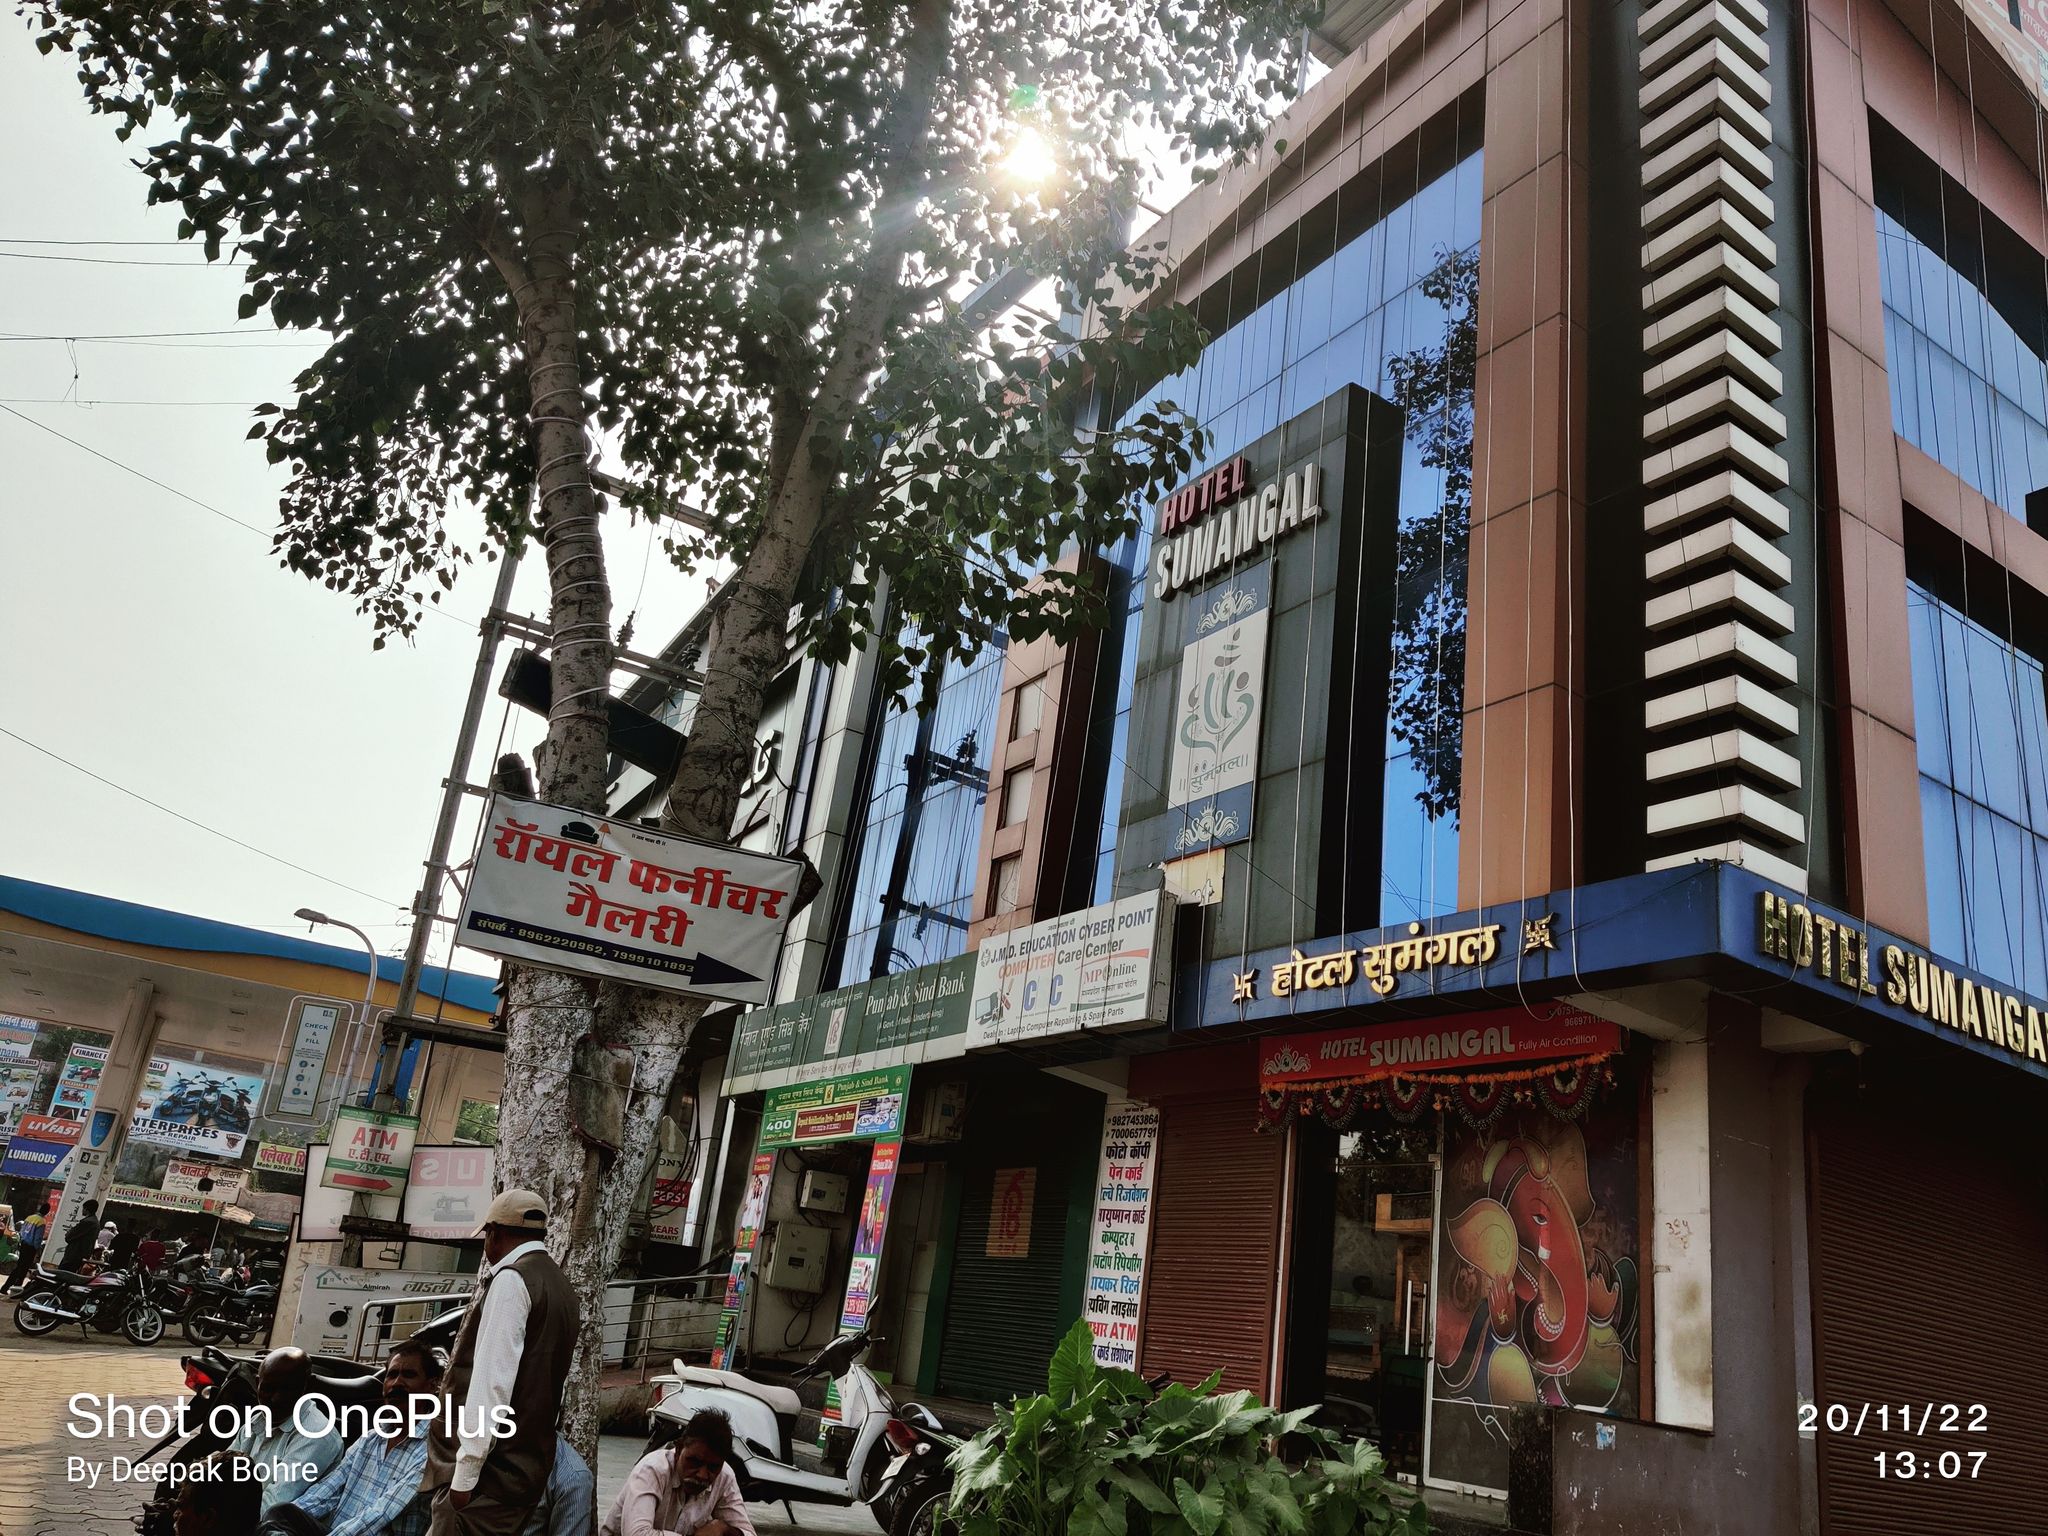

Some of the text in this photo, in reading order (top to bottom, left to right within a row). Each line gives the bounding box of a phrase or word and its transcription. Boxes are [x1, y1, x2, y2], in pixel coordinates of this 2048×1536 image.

[1160, 455, 1247, 538] HOTEL
[1153, 462, 1323, 601] SUMANGAL
[494, 817, 789, 920] रॉयल फर्नीचर
[565, 880, 695, 947] गैलरी
[991, 907, 1154, 963] J.M.D. EDUCATION CYBER POINT
[998, 938, 1125, 980] COMPUTER Care Center
[1271, 921, 1501, 998] होटल सुमंगल
[1759, 890, 2048, 1063] HOTEL SUMANGA
[865, 988, 900, 1018] Punjab
[900, 985, 911, 1008] &
[912, 978, 937, 1005] Sind
[937, 971, 966, 999] Bank
[1107, 1007, 1124, 1018] Parts
[305, 1022, 329, 1031] CHECK
[1320, 1026, 1598, 1067] HOTEL SUMANGAL Fully Air Condition
[28, 1115, 80, 1136] LIVFAST
[766, 1119, 792, 1131] 400
[1110, 1127, 1157, 1139] 7000657791
[352, 1126, 399, 1151] ATM
[1105, 1141, 1128, 1160] फोटो
[7, 1148, 58, 1165] LUMINOUS
[1108, 1162, 1144, 1181] पेन कार्ड
[1132, 1205, 1146, 1225] कार्ड
[1109, 1322, 1137, 1342] ATM
